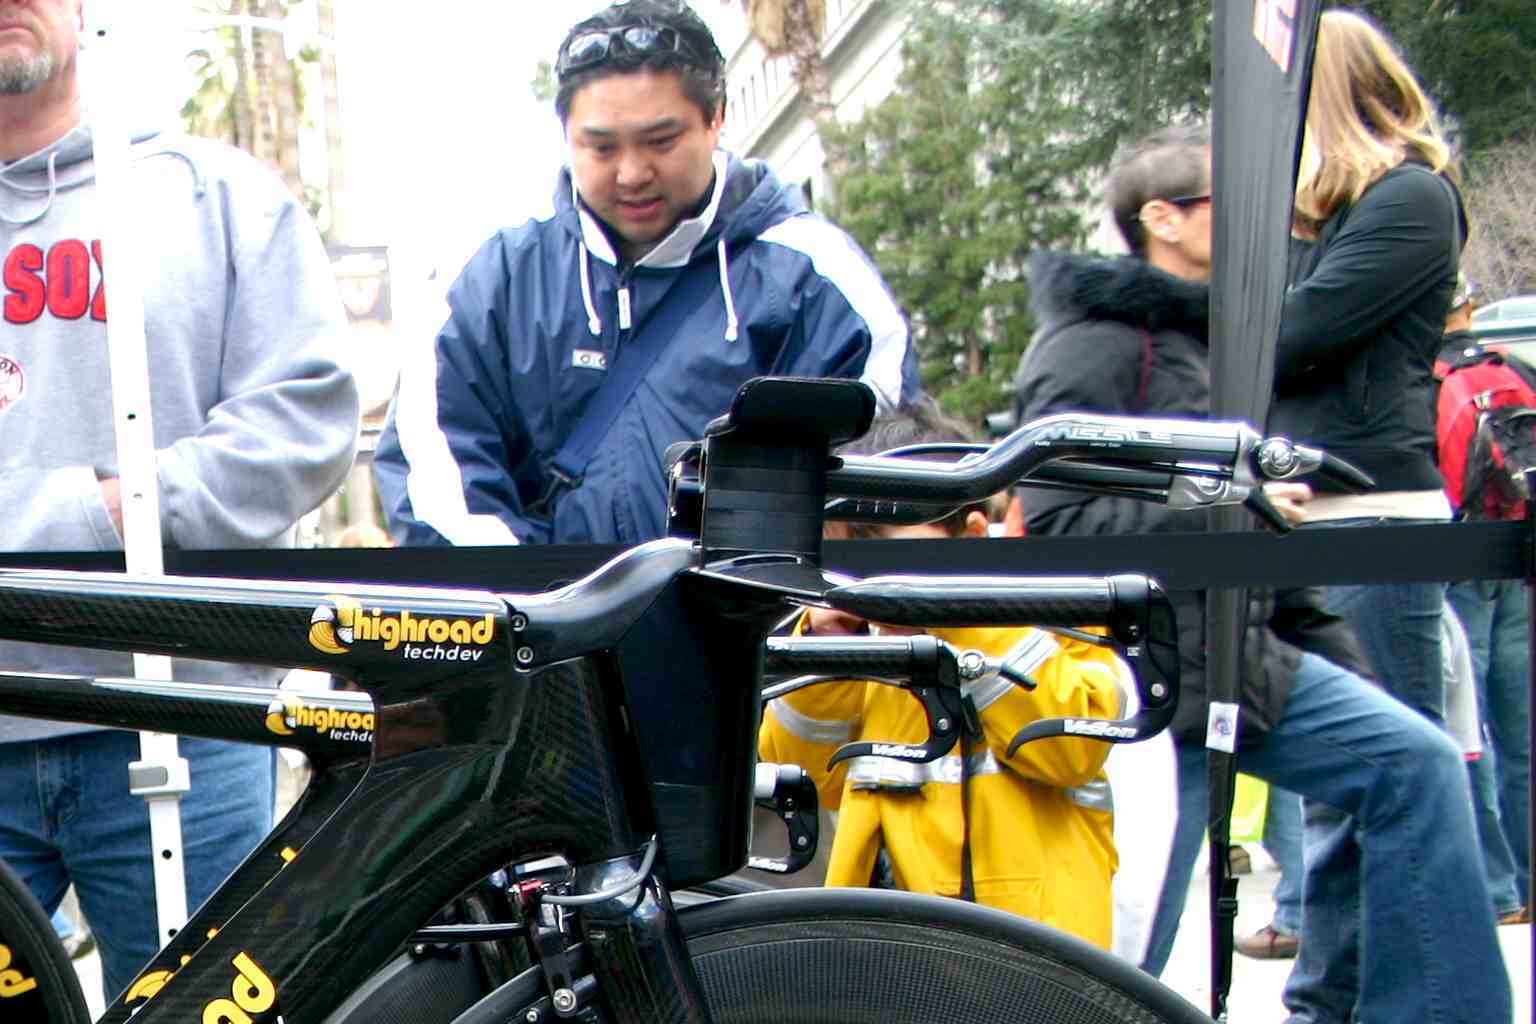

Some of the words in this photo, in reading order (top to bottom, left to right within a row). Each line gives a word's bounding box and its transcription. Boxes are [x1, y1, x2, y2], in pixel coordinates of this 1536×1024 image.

[353, 606, 497, 651] highroad
[402, 643, 483, 661] techdev
[295, 703, 376, 733] highroa
